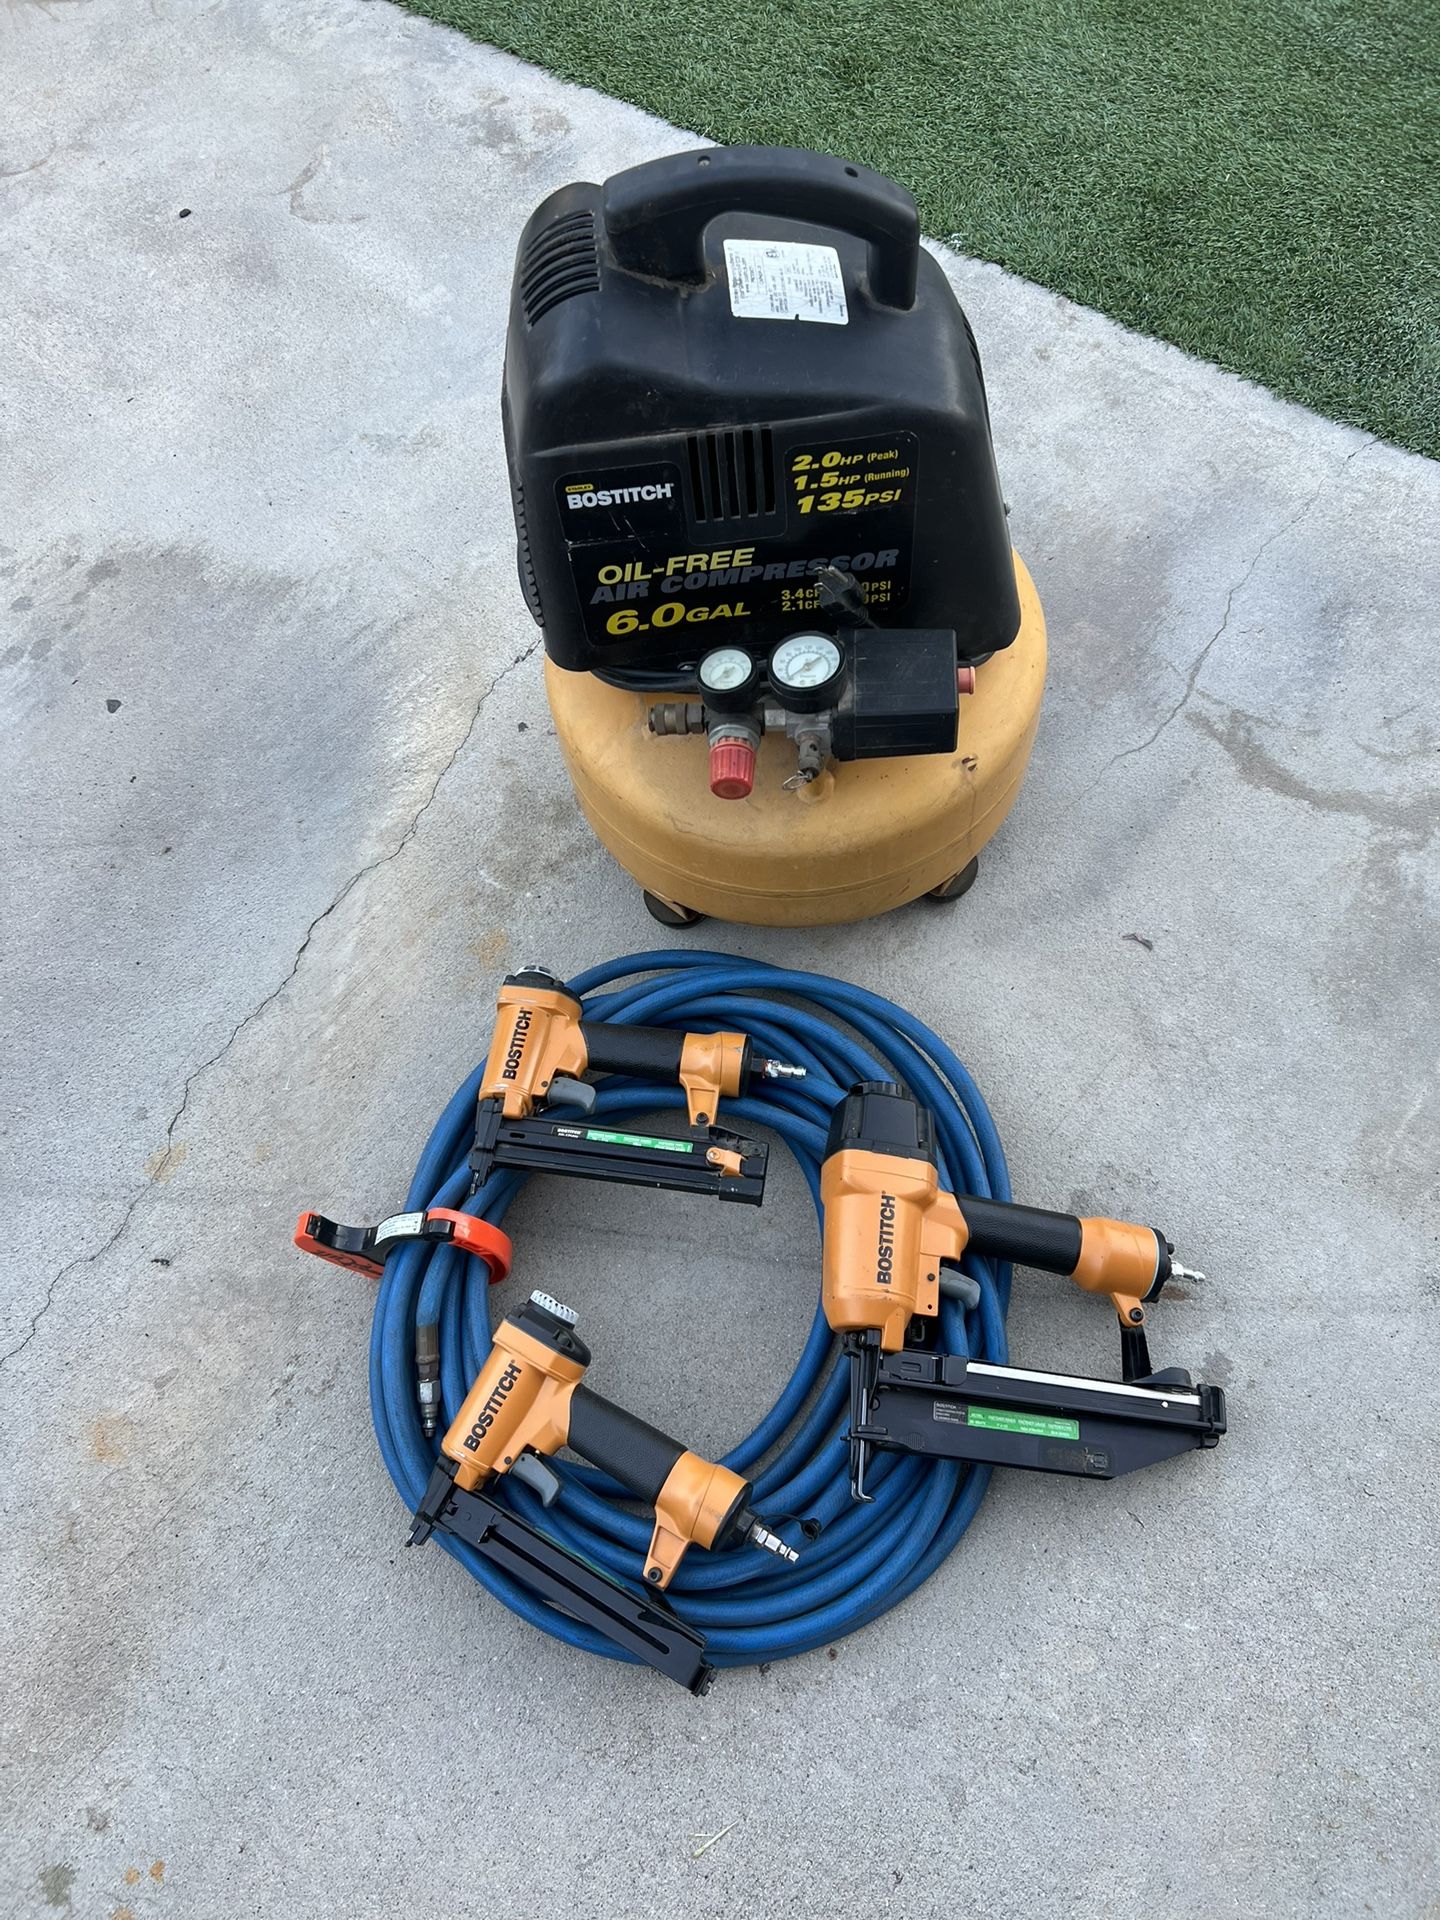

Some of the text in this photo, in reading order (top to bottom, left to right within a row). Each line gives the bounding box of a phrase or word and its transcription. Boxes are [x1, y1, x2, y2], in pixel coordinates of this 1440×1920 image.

[792, 449, 899, 472] 2.0HP (Peak)
[794, 467, 910, 491] 1.5HP (Running)
[566, 483, 673, 510] BOSTITCH
[797, 488, 902, 514] 135PSI
[589, 548, 900, 605] AIR COMPRESSOR
[597, 547, 756, 586] OIL-FREE
[781, 588, 821, 601] 3.4CF
[781, 600, 821, 611] 2.1CF
[606, 602, 751, 636] 6.0GAL
[502, 1009, 533, 1080] BOSTITCH
[876, 1194, 896, 1285] BOSTITCH
[463, 1362, 522, 1453] BOSTITCH
